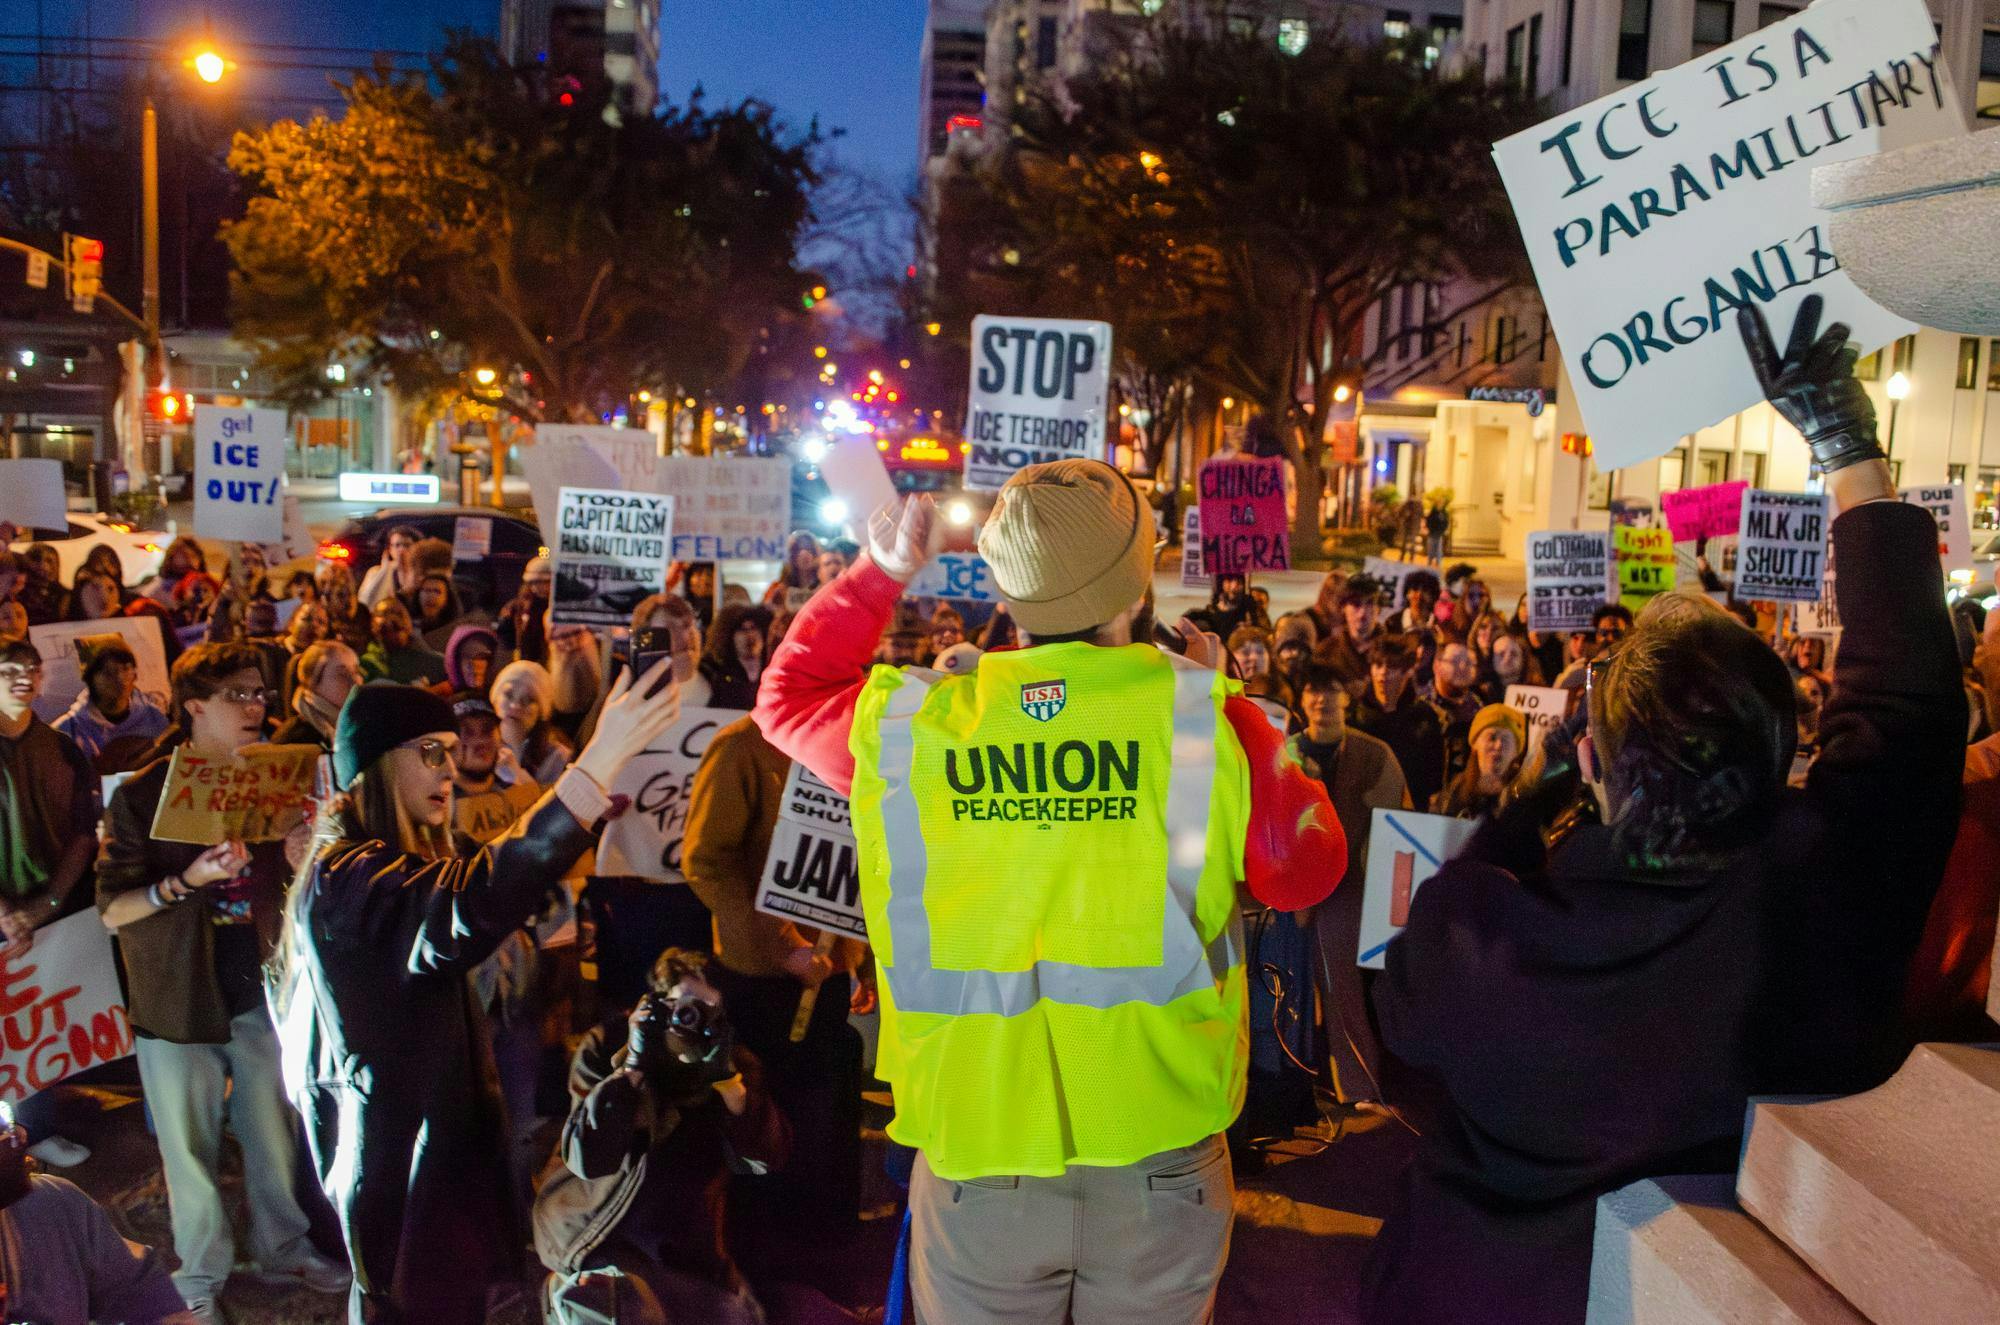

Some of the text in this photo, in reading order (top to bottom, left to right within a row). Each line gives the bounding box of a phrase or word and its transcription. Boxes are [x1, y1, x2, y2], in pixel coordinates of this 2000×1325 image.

[1540, 27, 1832, 199] ICE IS A
[1553, 42, 1942, 268] PARAMILITARY
[1581, 224, 1842, 389] ORGANIZ
[978, 326, 1095, 400] STOP
[973, 411, 1088, 450] ICE TERROR
[213, 441, 258, 468] ICE
[207, 477, 278, 505] OUT!
[1201, 462, 1284, 498] CHINGA
[1751, 495, 1822, 508] HONOR
[1921, 488, 1953, 502] DUE
[563, 507, 666, 536] CAPITALISM
[1231, 503, 1255, 526] LA
[1747, 511, 1790, 541] MLK
[1793, 514, 1822, 542] JR
[561, 533, 663, 558] HAS OUTLIVED
[671, 533, 785, 560] FELON!
[1745, 545, 1820, 577] SHUT IT
[937, 556, 990, 599] ICE
[1630, 567, 1662, 585] NOT
[1533, 584, 1605, 597] STOP
[1024, 686, 1063, 703] USA
[1515, 693, 1540, 709] NO
[945, 740, 1140, 795] UNION
[170, 785, 194, 811] A
[952, 796, 1137, 822] PEACEKEEPER
[0, 985, 82, 1060] UT
